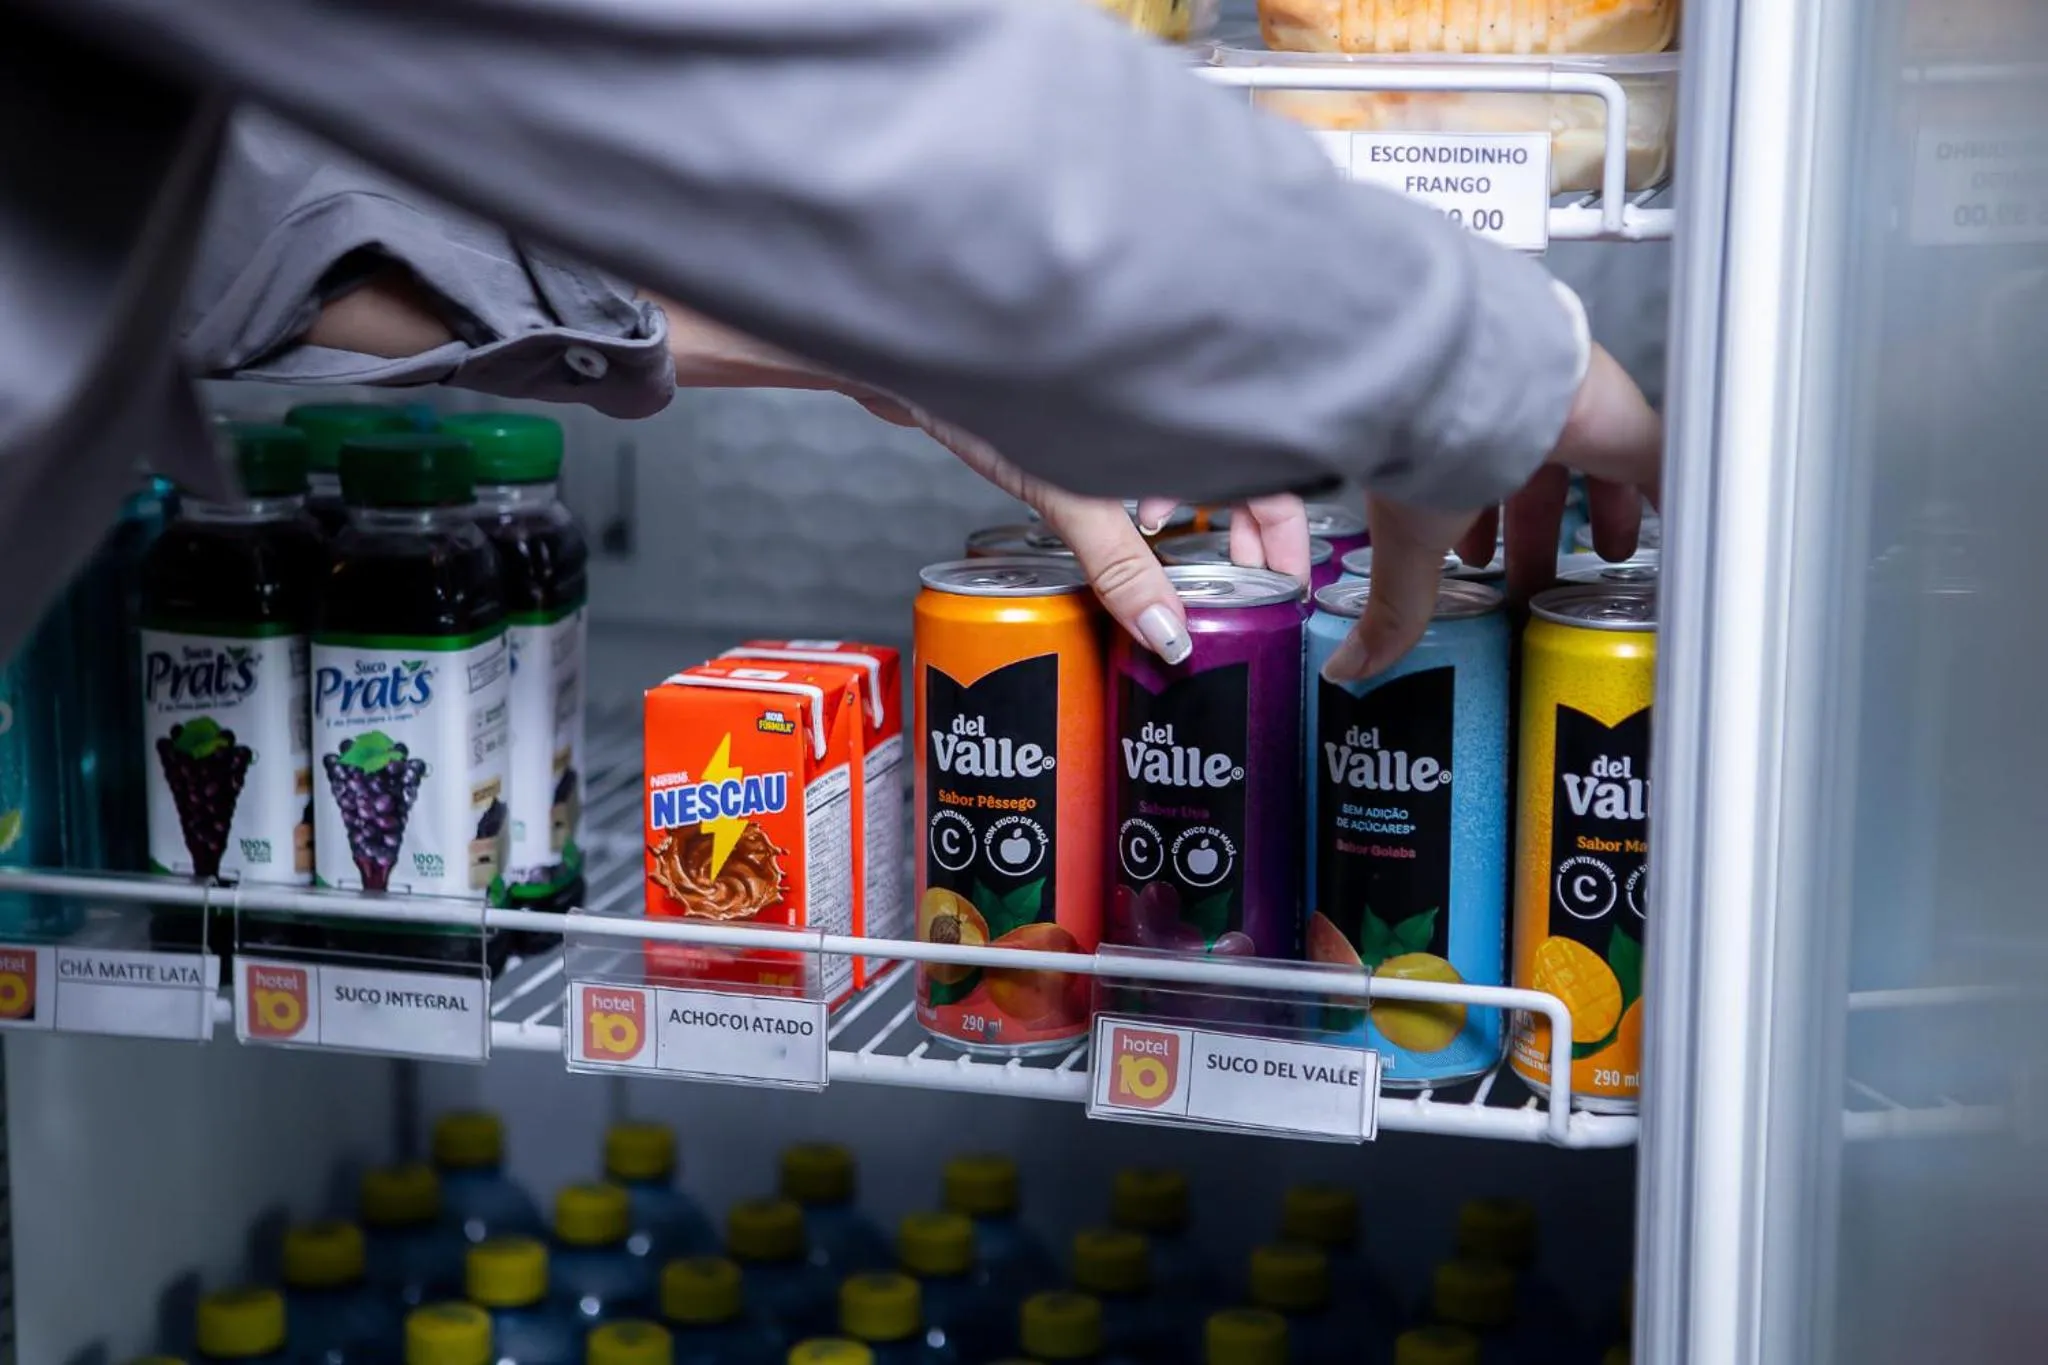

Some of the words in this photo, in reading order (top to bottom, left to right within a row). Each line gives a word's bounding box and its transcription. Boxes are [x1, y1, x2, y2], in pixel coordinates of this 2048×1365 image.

[1371, 145, 1528, 165] ESCONDIDINHO
[1406, 176, 1492, 194] FRANGO
[354, 660, 387, 676] Suco
[952, 713, 986, 737] del
[1141, 721, 1175, 745] del
[1345, 725, 1380, 749] del
[932, 730, 1043, 778] Valle
[1121, 738, 1232, 787] Valle
[1591, 754, 1632, 778] del
[1324, 741, 1439, 792] Valle
[651, 772, 788, 829] NESCAU
[938, 789, 975, 807] Sabor
[977, 795, 1038, 811] Pêssego
[1342, 803, 1363, 815] SEM
[1365, 806, 1409, 820] ADIÇÃO
[983, 825, 998, 845] COM
[995, 815, 1019, 829] SUCO
[1336, 816, 1349, 828] DE
[941, 827, 960, 855] C
[1130, 836, 1148, 863] C
[1171, 835, 1185, 854] COM
[1182, 825, 1207, 838] SUCO
[1576, 835, 1623, 853] Sabor
[1559, 858, 1576, 873] COM
[1575, 855, 1616, 881] VITAMINA
[1573, 875, 1598, 903] C
[60, 958, 94, 977] CHÁ
[99, 961, 155, 982] MATTE
[160, 966, 201, 985] LATA
[255, 971, 299, 990] hotel
[335, 985, 381, 1005] SUCO
[385, 990, 470, 1012] INTEGRAL
[591, 993, 635, 1013] hotel
[961, 1013, 984, 1033] 290
[1122, 1035, 1169, 1056] hotel
[1207, 1053, 1258, 1074] SUCO
[1263, 1060, 1298, 1080] DEL
[1303, 1064, 1360, 1087] VALLE
[1593, 1068, 1620, 1087] 290
